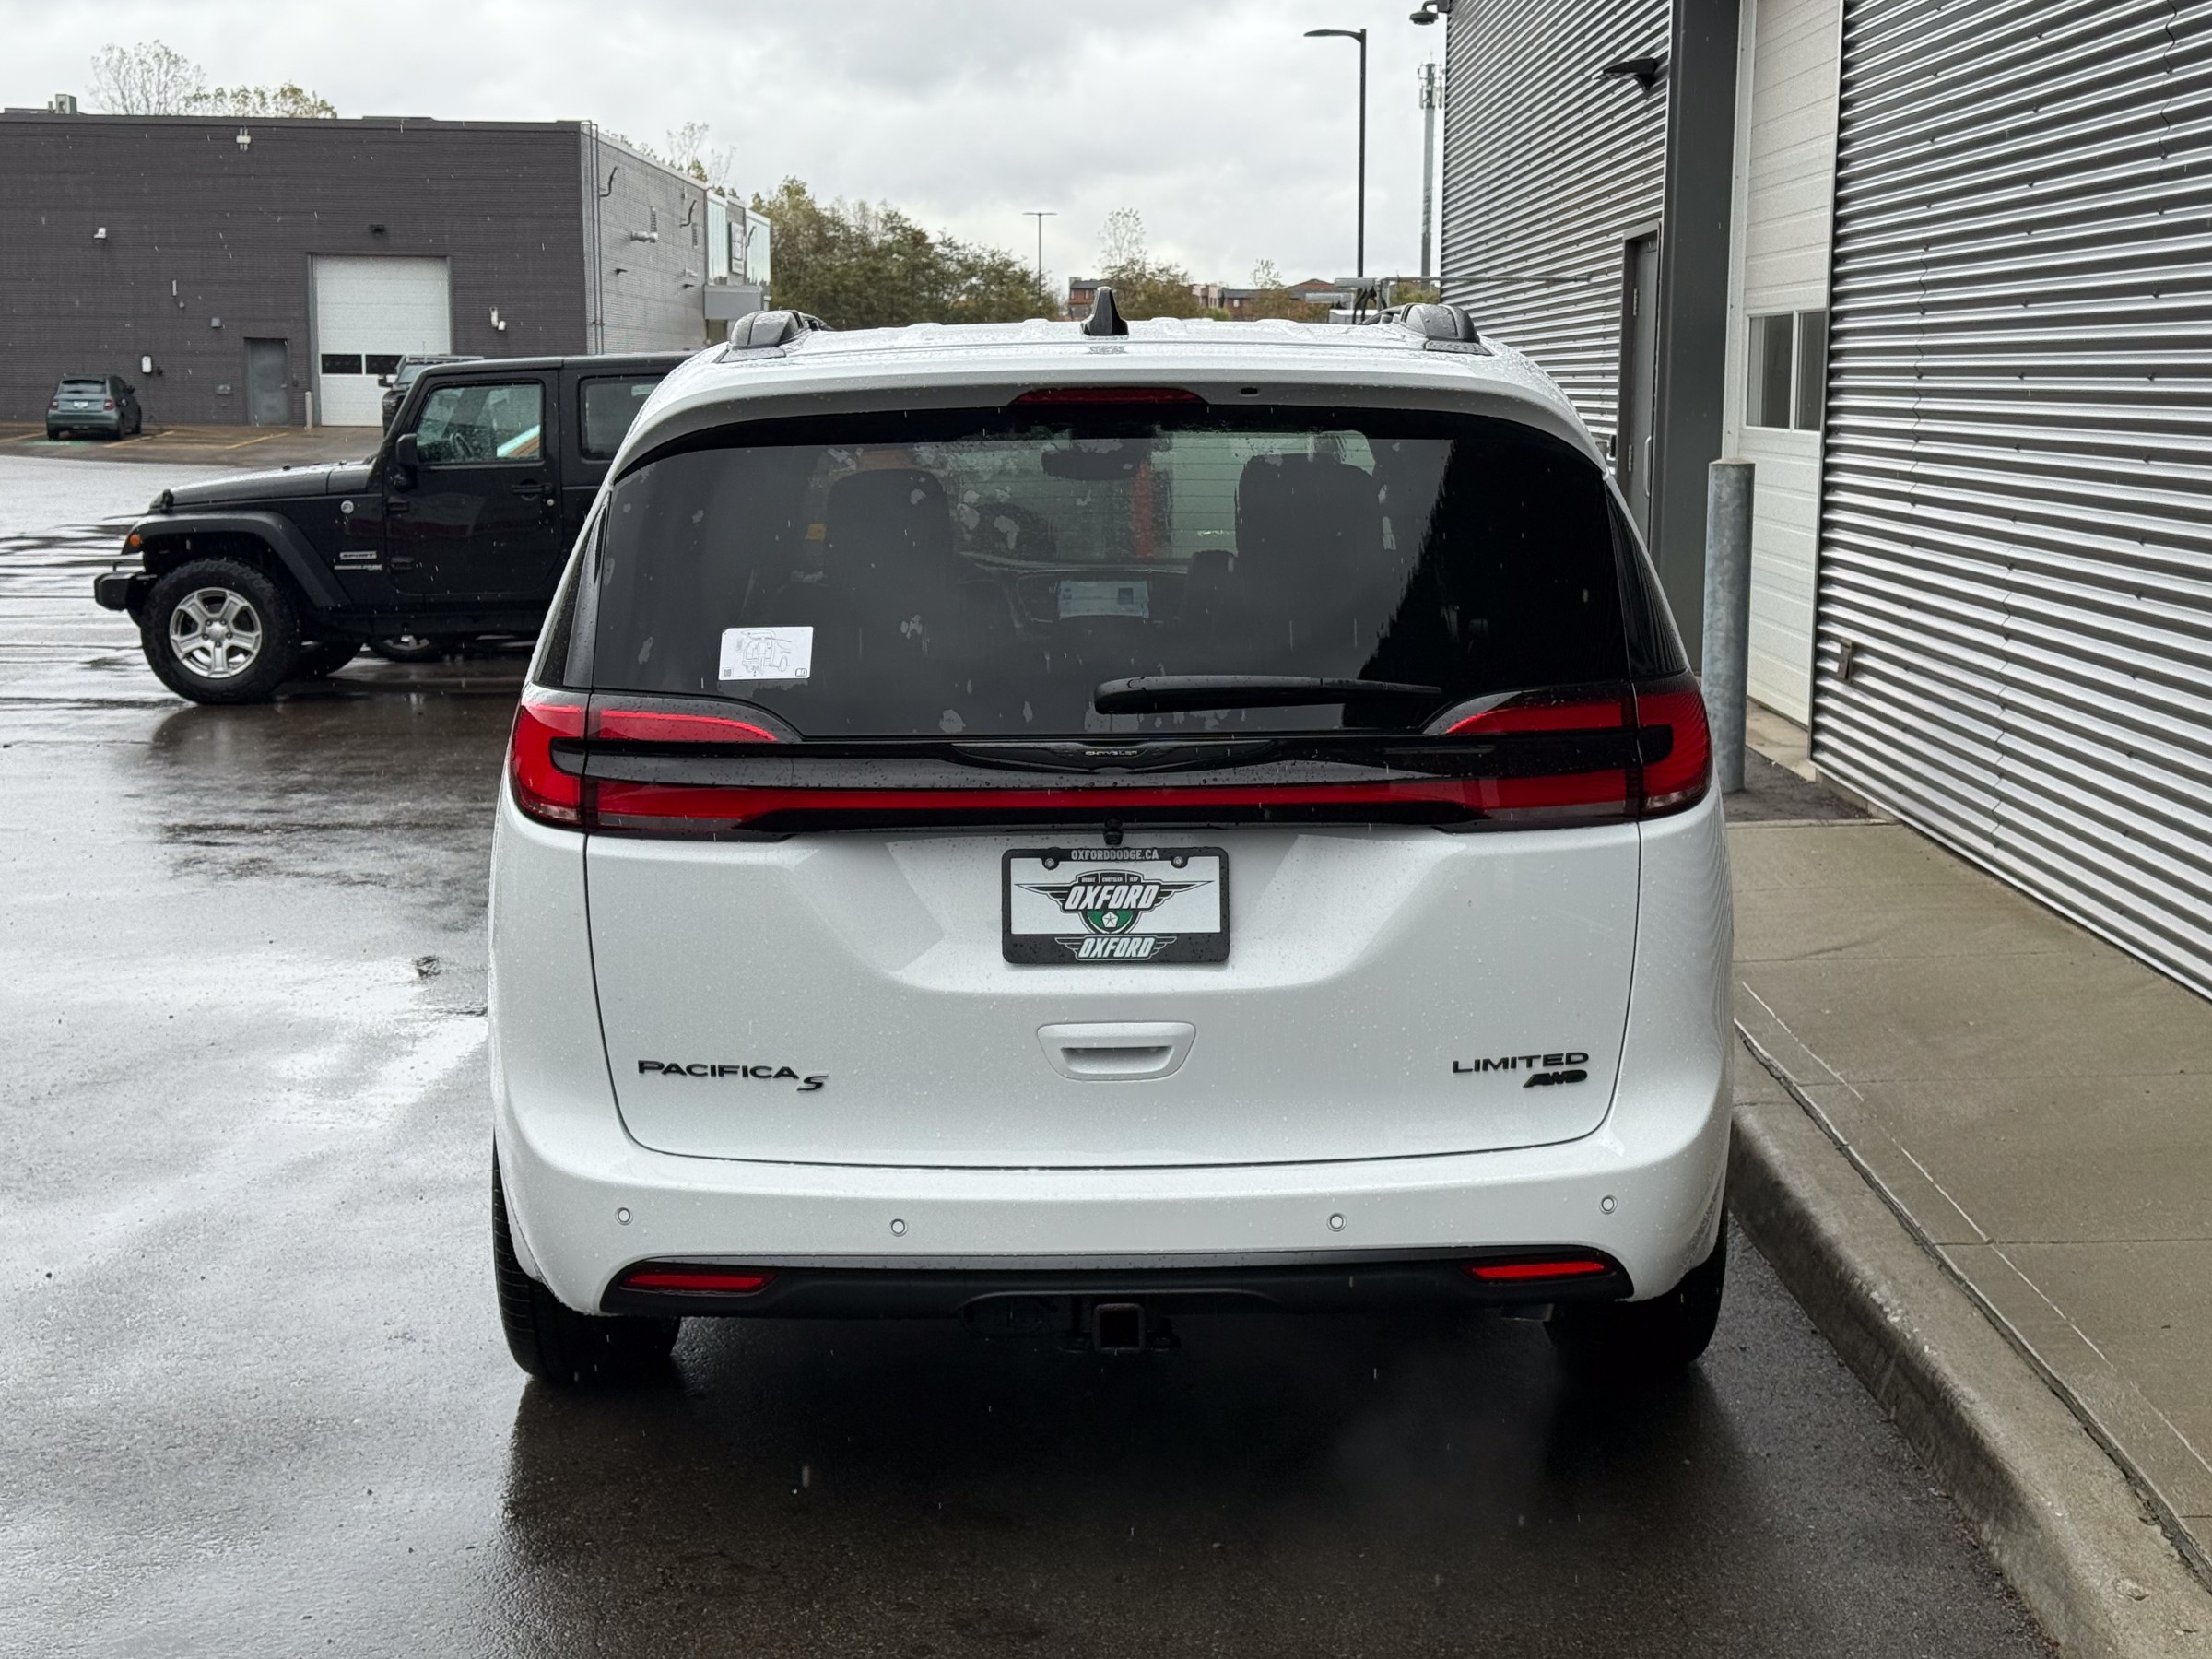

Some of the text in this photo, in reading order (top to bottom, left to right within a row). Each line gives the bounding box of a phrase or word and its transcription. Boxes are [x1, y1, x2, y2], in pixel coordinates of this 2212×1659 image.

[1071, 849, 1159, 860] OXFORDDODGE.CA
[1065, 884, 1159, 910] OXFORD
[1078, 936, 1156, 958] OXFORD
[1453, 1052, 1589, 1073] LIMITED
[638, 1060, 829, 1091] PACIFICA S
[1523, 1069, 1588, 1088] AWD
